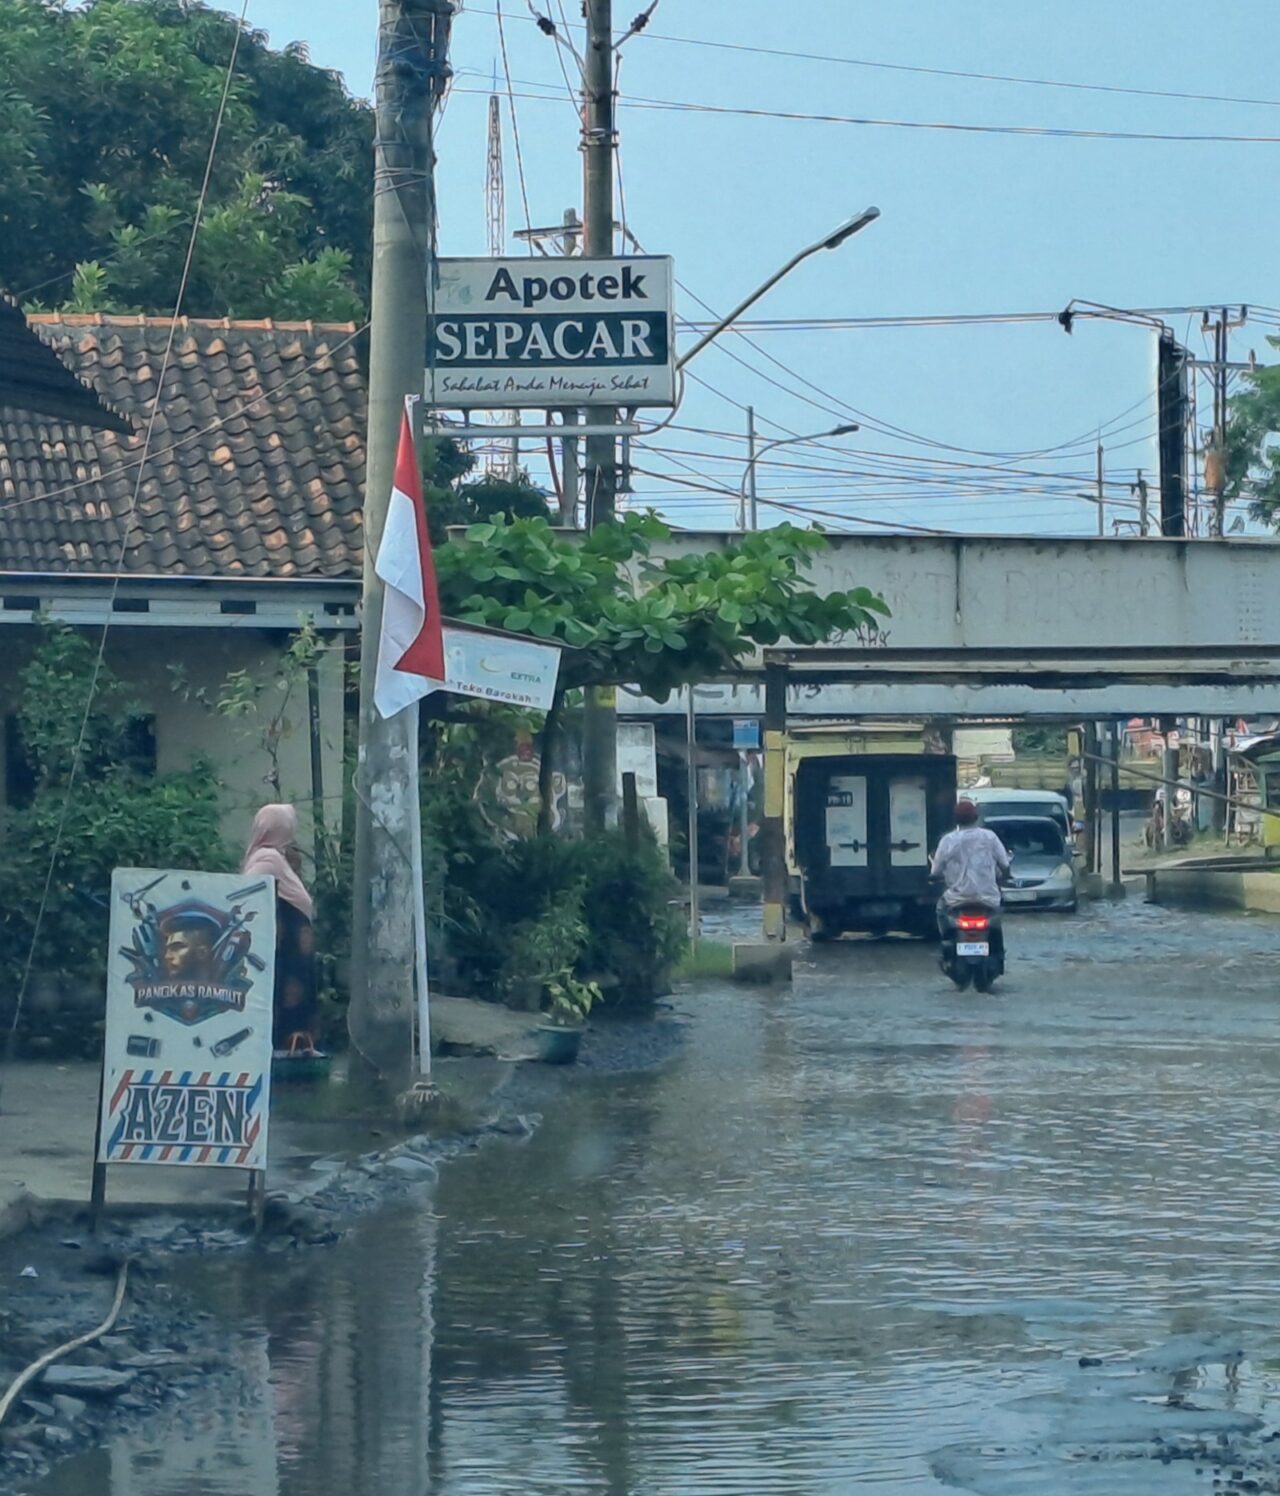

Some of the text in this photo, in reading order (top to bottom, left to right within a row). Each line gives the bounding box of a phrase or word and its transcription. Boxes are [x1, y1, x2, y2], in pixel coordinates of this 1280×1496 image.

[485, 266, 648, 307] Apotek
[435, 319, 654, 360] SEPACAR
[441, 376, 500, 392] Sahabat
[503, 376, 544, 392] Anda
[610, 374, 649, 391] Sehat
[137, 984, 196, 1000] PANGKAS
[124, 1087, 248, 1144] AZEN
